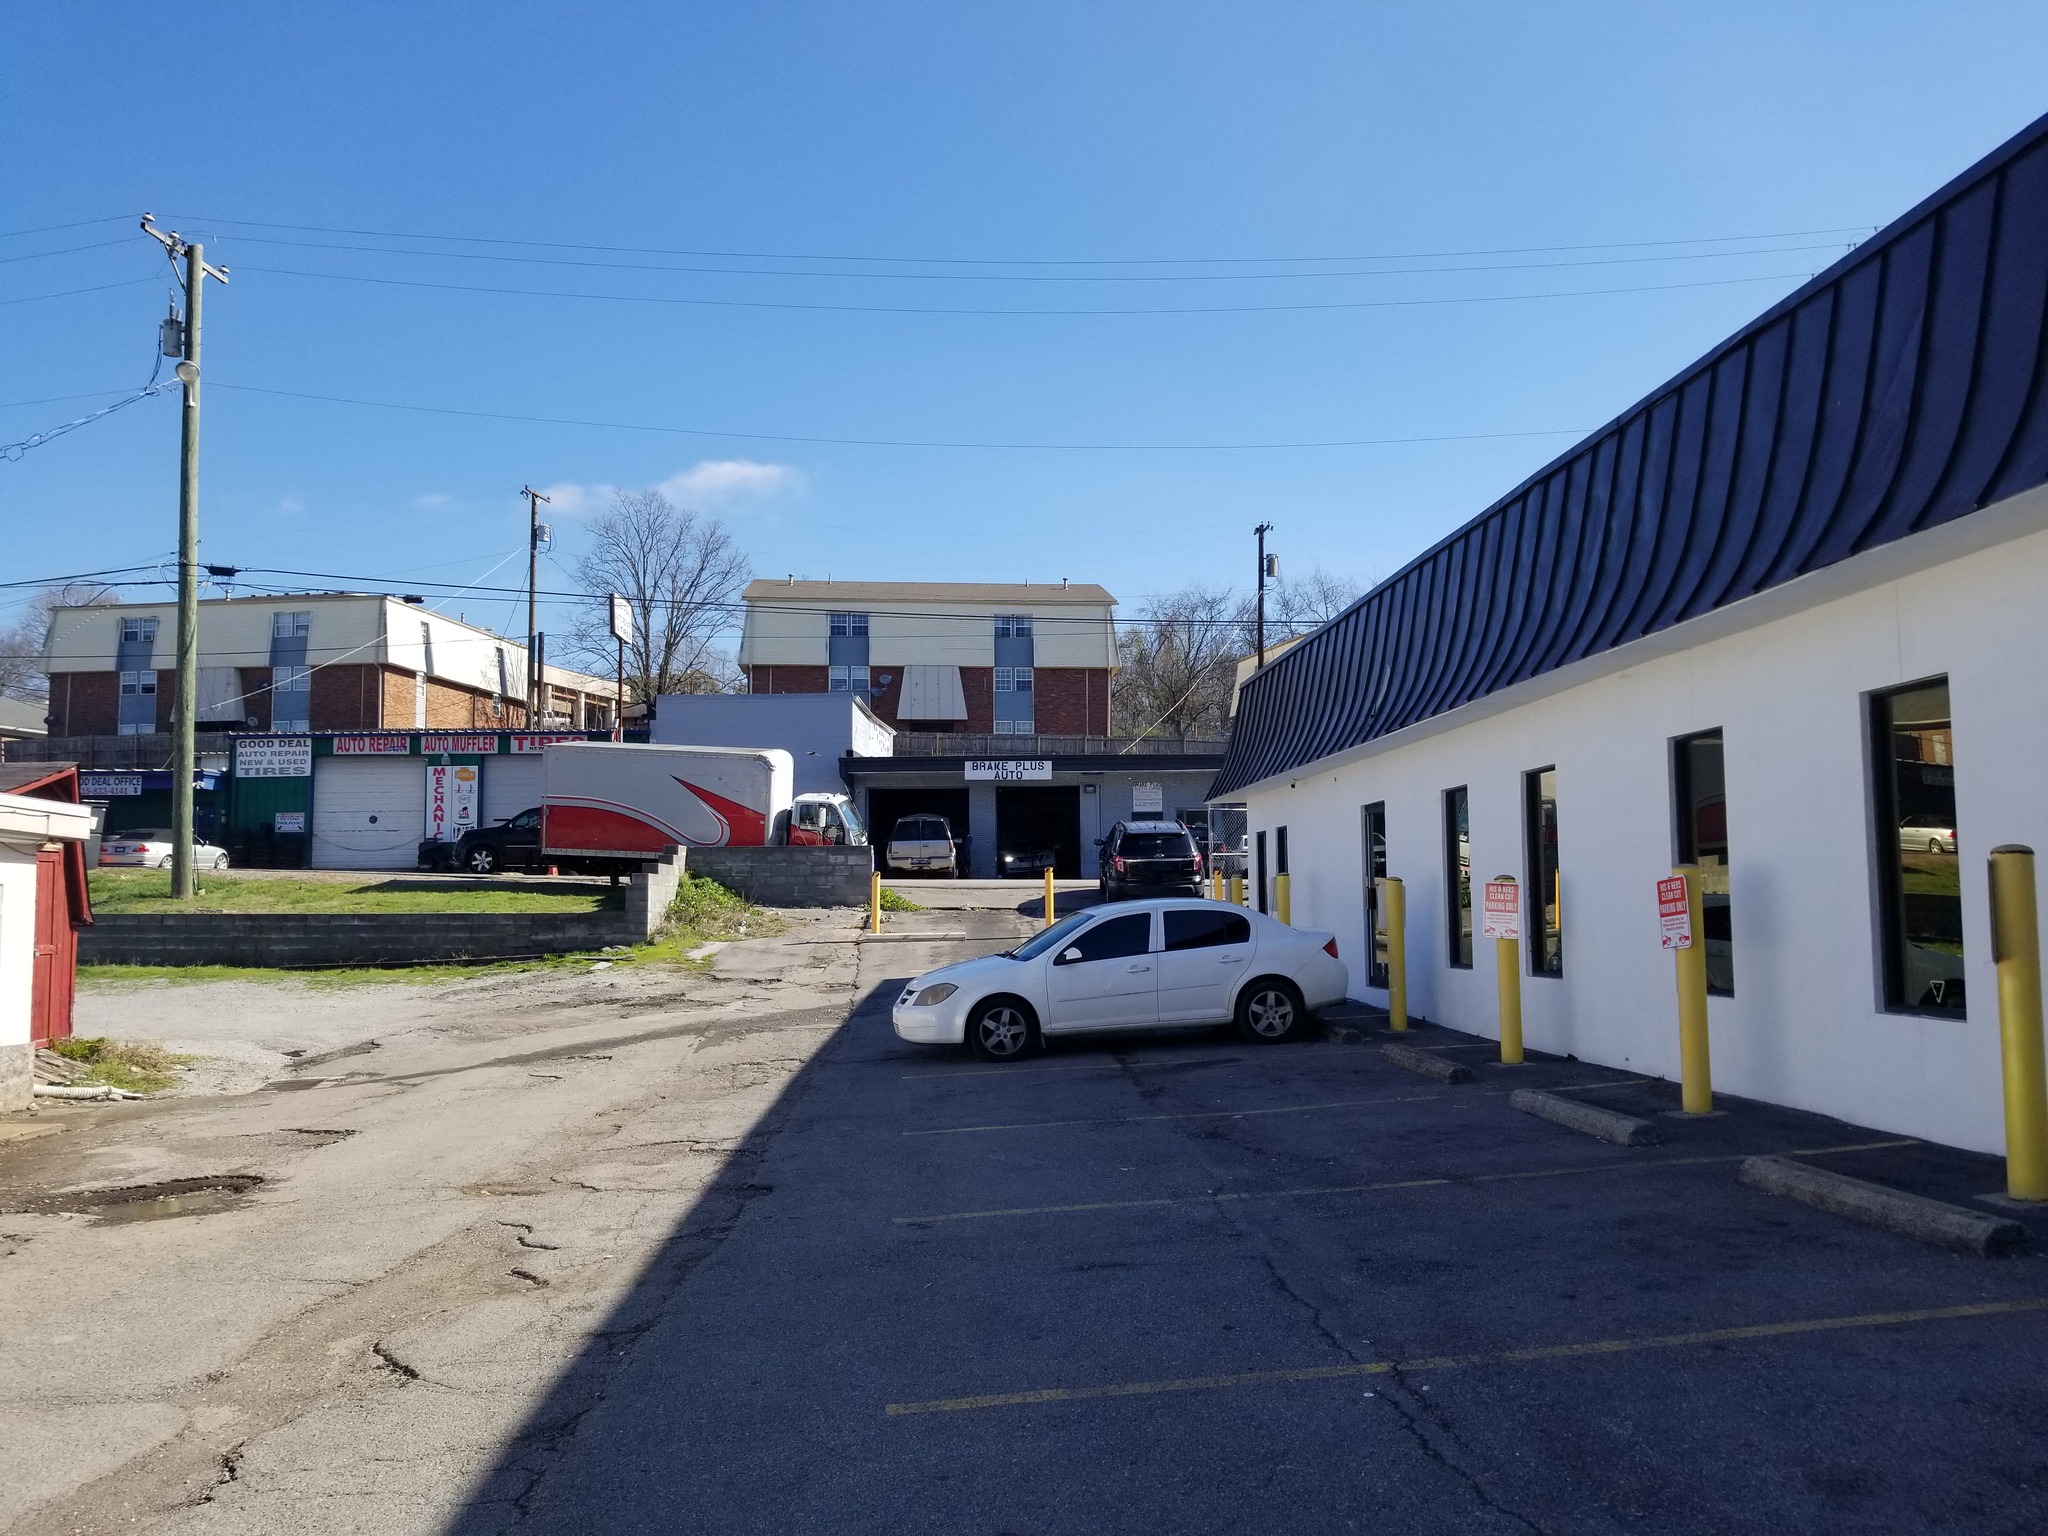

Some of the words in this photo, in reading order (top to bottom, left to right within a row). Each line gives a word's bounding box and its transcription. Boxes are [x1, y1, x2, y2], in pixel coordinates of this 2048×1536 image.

[239, 740, 275, 748] GOOD
[278, 739, 310, 748] DEAL
[336, 737, 365, 752] AUTO
[369, 737, 407, 752] REPAIR
[424, 736, 449, 752] AUTO
[452, 736, 495, 752] MUFFLER
[278, 758, 307, 766] USED
[972, 761, 1008, 771] BRAKE
[1015, 761, 1045, 771] PLUS
[240, 766, 306, 776] TIRES
[994, 770, 1023, 780] AUTO
[91, 777, 111, 786] DEAL
[114, 777, 141, 786] OFFICE
[433, 767, 446, 841] MECHANIC
